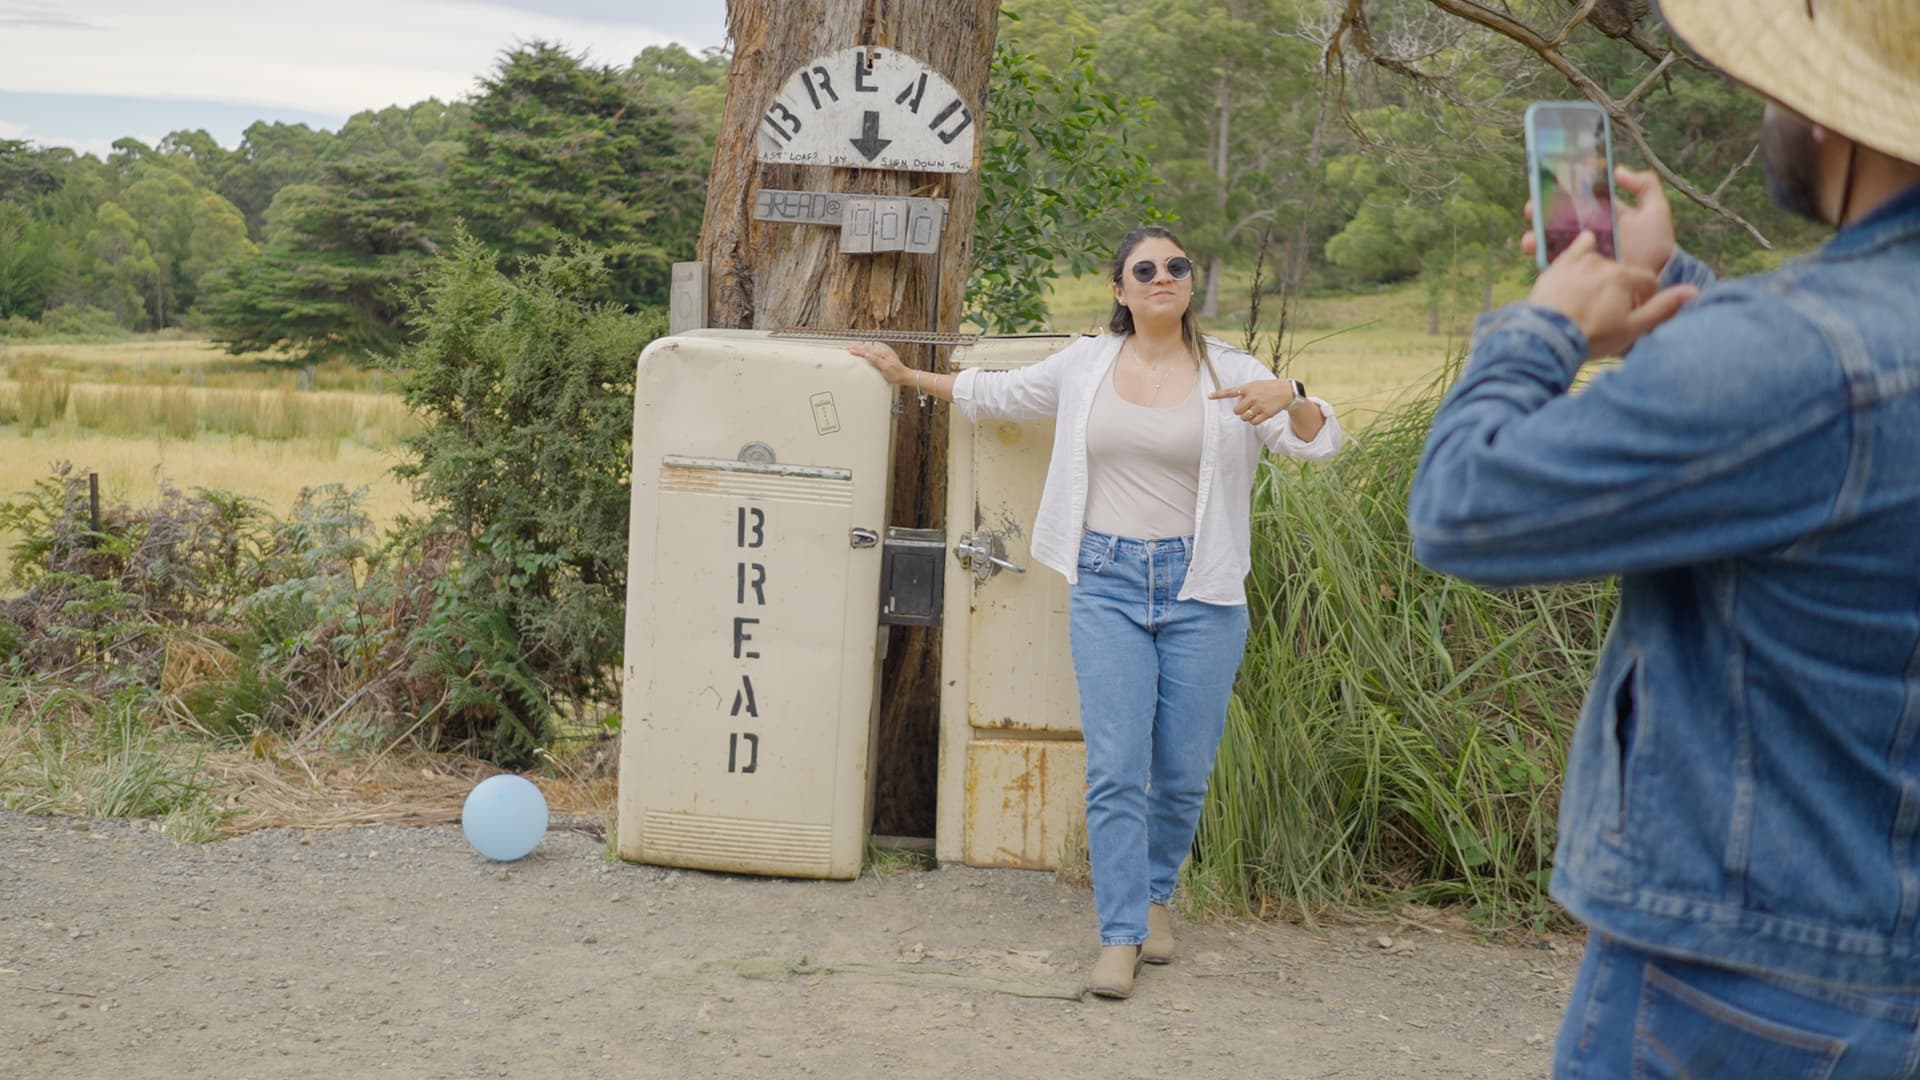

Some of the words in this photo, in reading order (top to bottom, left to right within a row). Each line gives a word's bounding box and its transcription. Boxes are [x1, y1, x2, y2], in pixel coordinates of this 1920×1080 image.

[764, 52, 972, 144] BREAD
[789, 151, 818, 164] LOAF?
[914, 158, 945, 169] DOWN
[728, 506, 766, 775] BREAD
